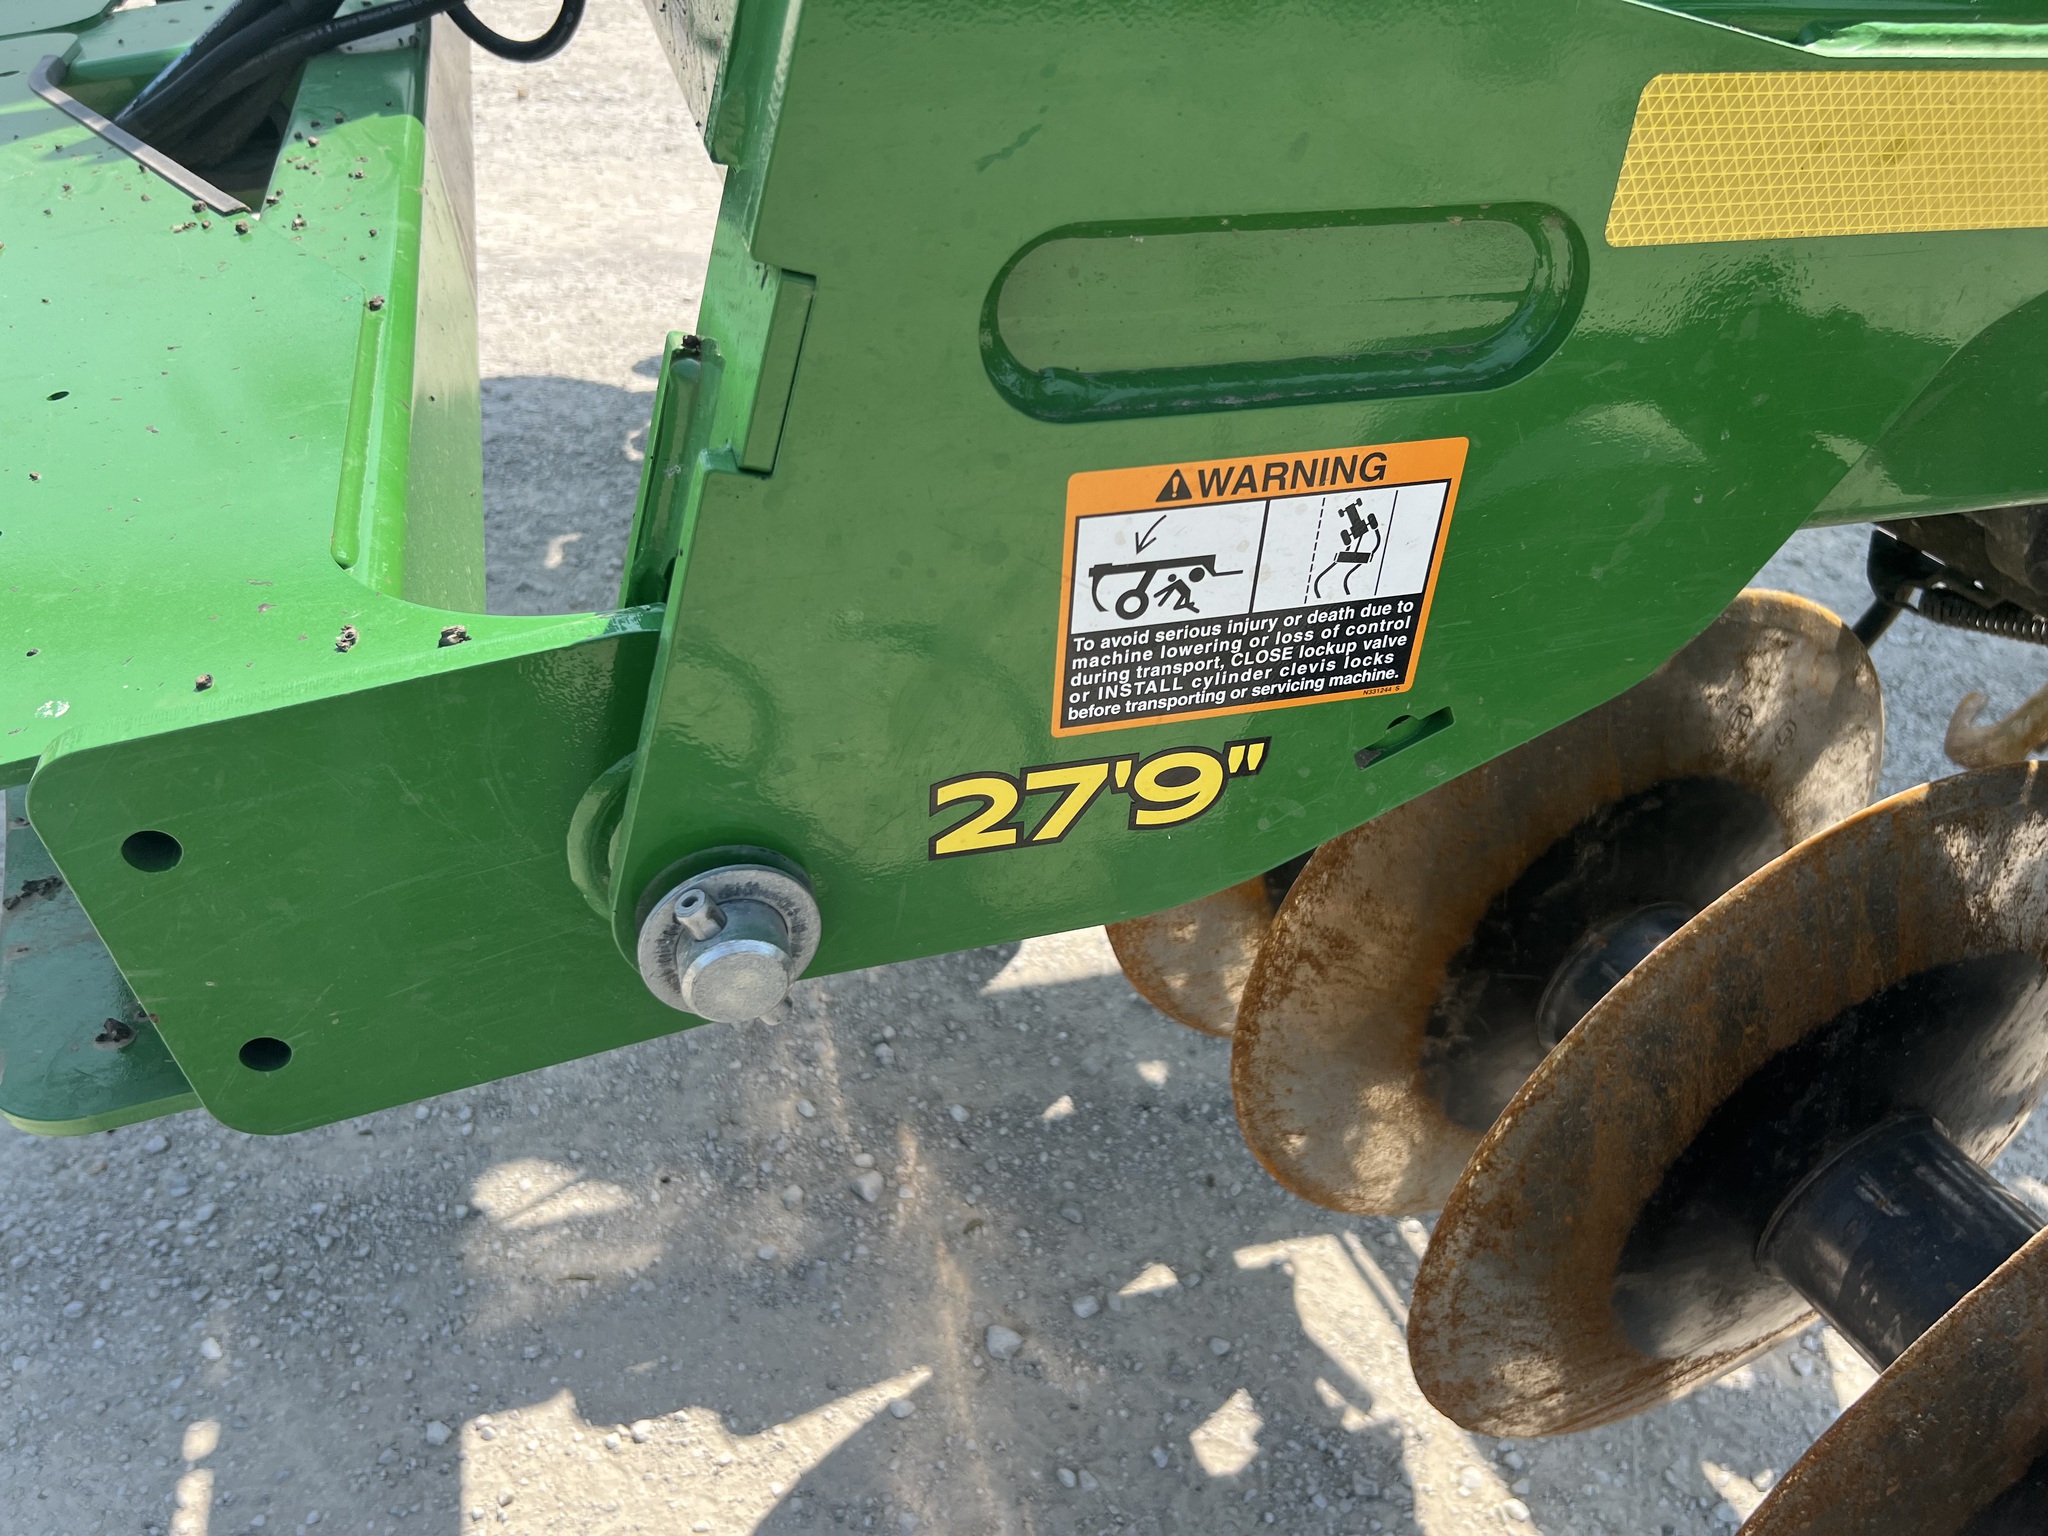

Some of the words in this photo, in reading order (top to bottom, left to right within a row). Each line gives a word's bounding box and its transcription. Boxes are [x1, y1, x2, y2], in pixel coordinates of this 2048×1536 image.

[1198, 452, 1388, 498] WARNING
[1072, 649, 1153, 669] machine
[1160, 638, 1242, 659] lowering
[1249, 636, 1270, 647] or
[1275, 629, 1314, 645] loss
[1321, 624, 1340, 639] of
[1346, 616, 1412, 636] control
[1073, 637, 1095, 652] To
[1100, 630, 1150, 649] avoid
[1154, 624, 1221, 643] serious
[1228, 616, 1278, 636] injury
[1283, 614, 1303, 627] or
[1307, 606, 1355, 624] death
[1360, 602, 1392, 618] due
[1397, 600, 1414, 613] to
[1069, 690, 1090, 704] or
[1097, 677, 1183, 701] INSTALL
[1191, 667, 1273, 690] cylinder
[1279, 659, 1336, 677] clevis
[1343, 652, 1395, 669] locks
[1070, 668, 1130, 686] during
[1136, 656, 1225, 679] transport,
[1230, 646, 1293, 667] CLOSE
[1299, 641, 1357, 659] lockup
[1363, 635, 1408, 650] valve
[1068, 703, 1121, 721] before
[1125, 689, 1226, 713] transporting
[1230, 686, 1248, 699] or
[1252, 677, 1324, 696] servicing
[1328, 668, 1399, 686] machine.
[929, 736, 1272, 860] 27'9"
